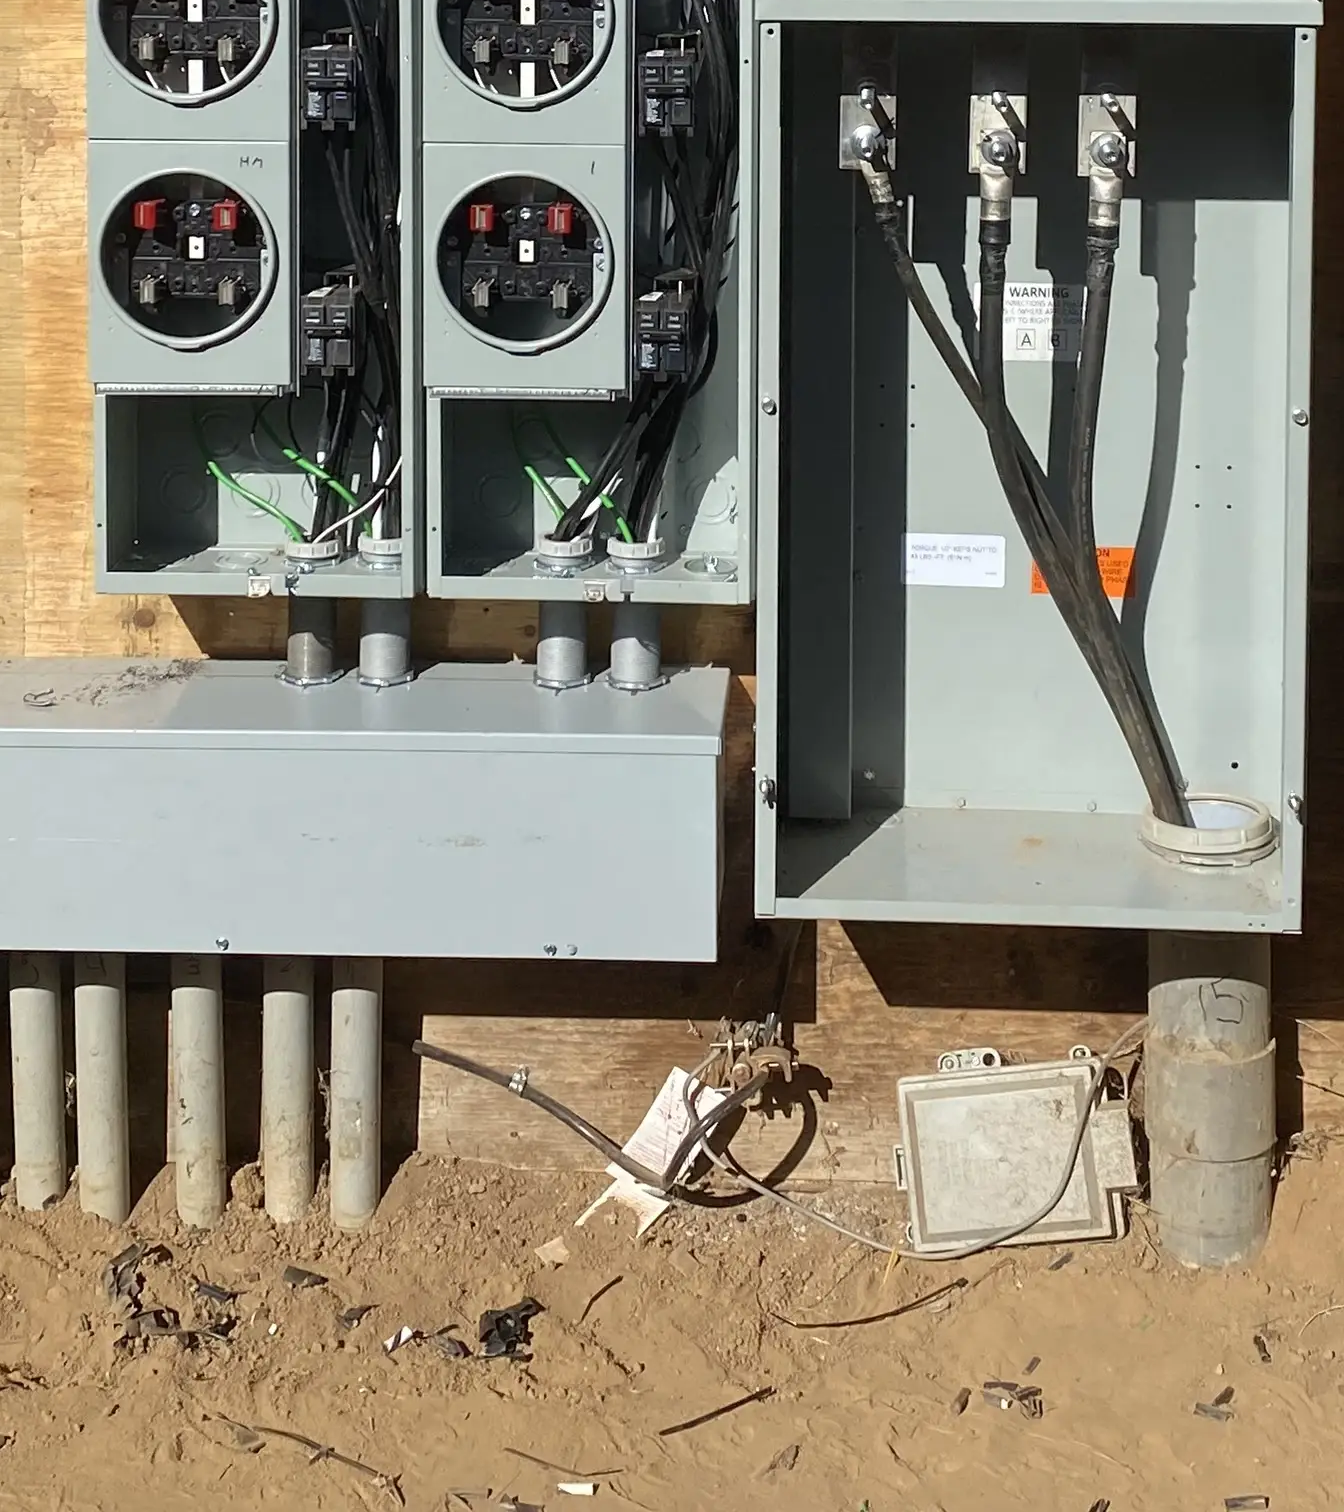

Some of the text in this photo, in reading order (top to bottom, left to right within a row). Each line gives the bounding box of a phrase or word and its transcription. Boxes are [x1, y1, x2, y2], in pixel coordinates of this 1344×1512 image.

[1009, 287, 1070, 298] WARNING
[1021, 333, 1061, 347] A B
